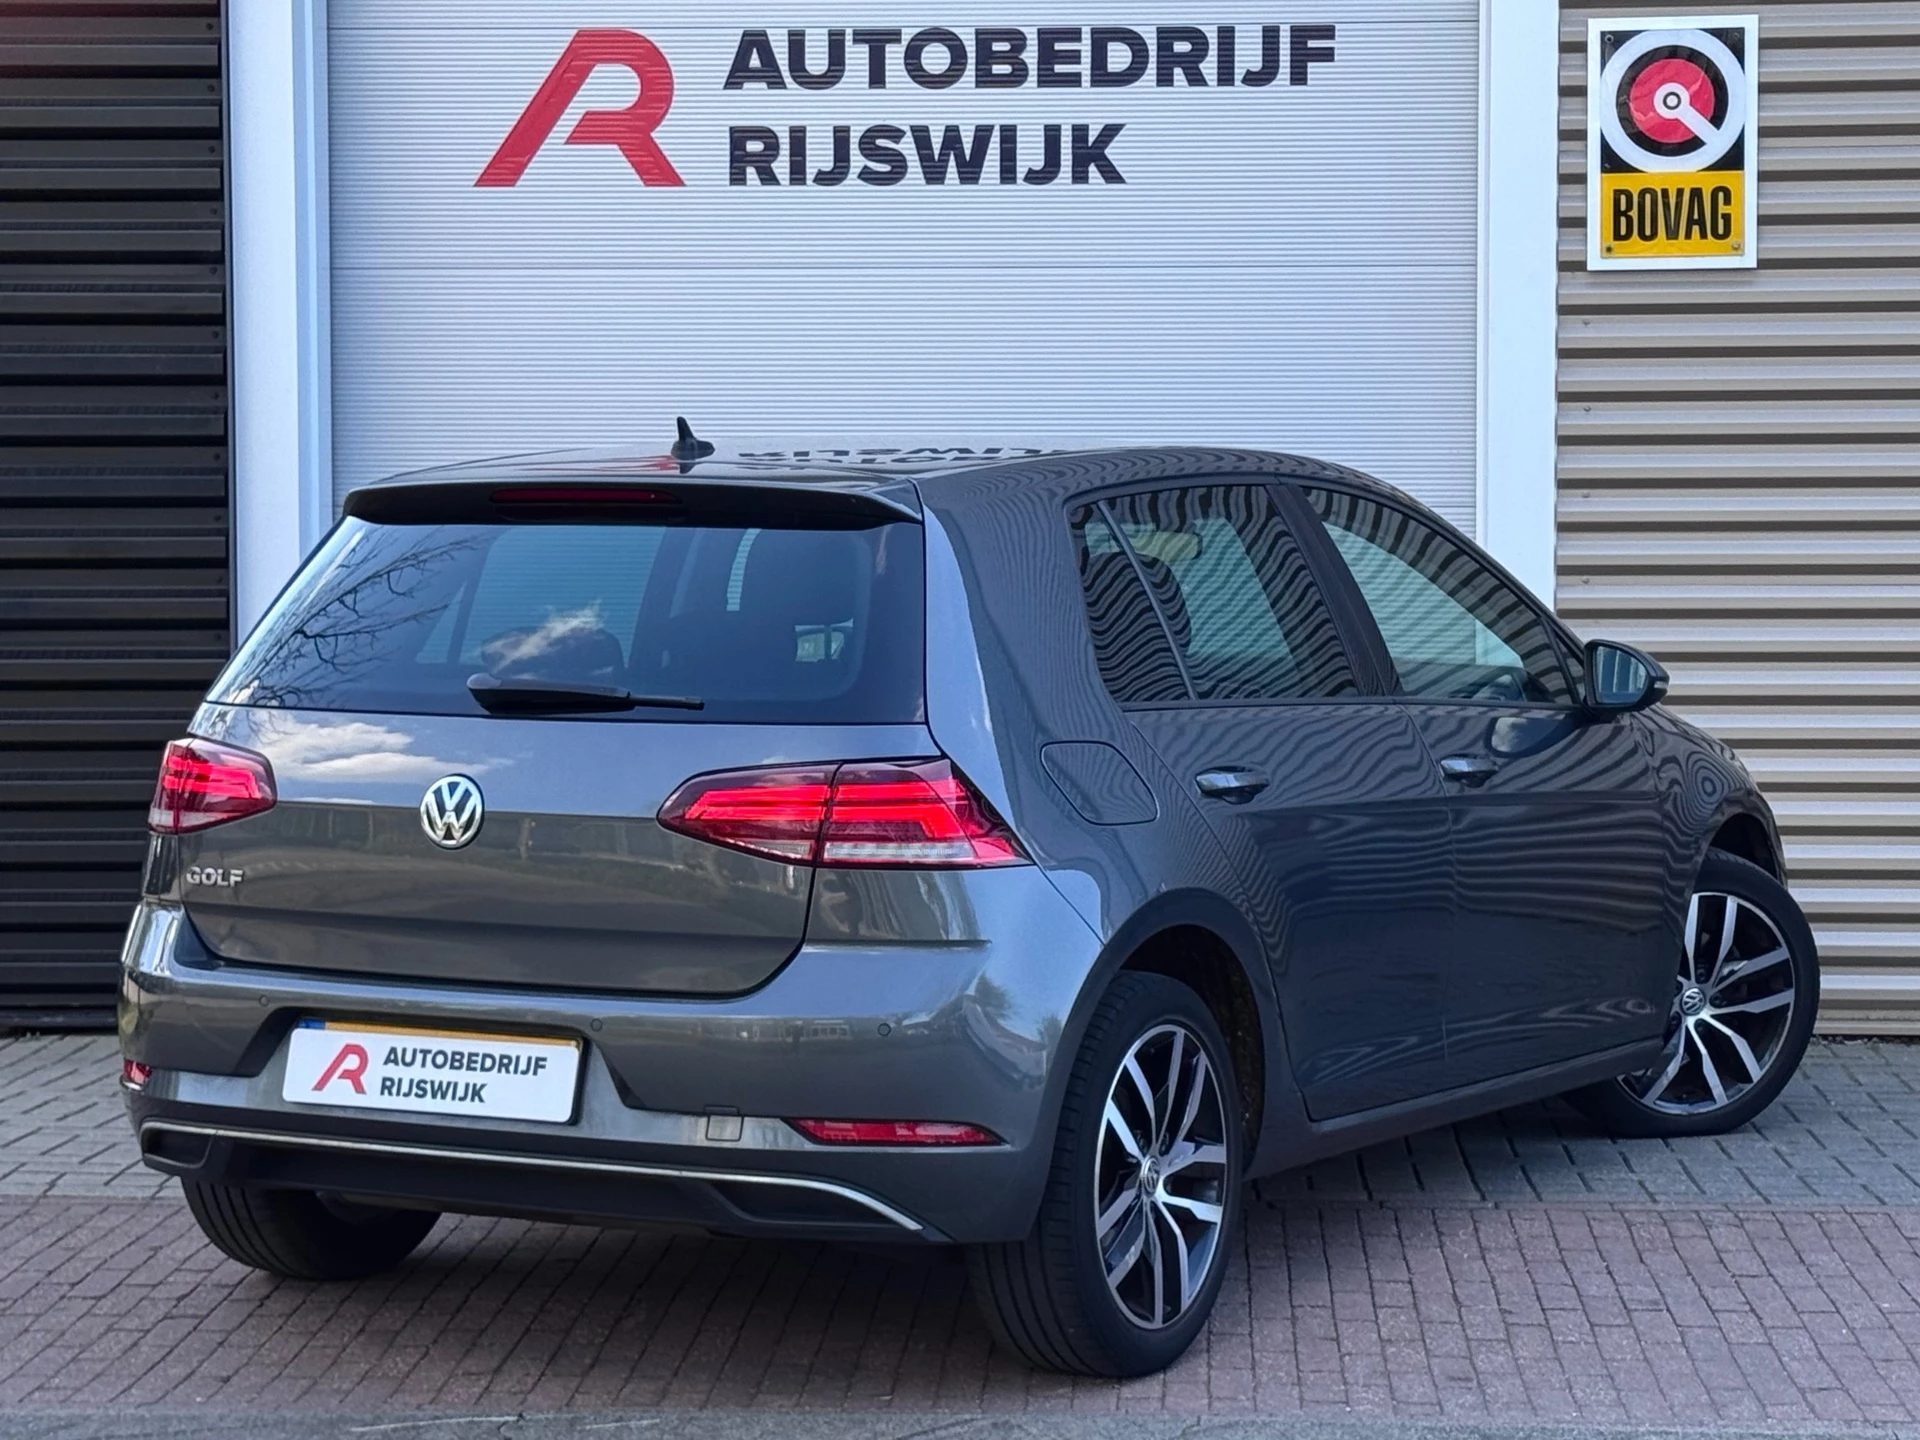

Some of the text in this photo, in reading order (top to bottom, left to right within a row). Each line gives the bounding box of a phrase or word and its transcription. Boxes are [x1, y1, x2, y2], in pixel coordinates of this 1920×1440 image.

[723, 25, 1335, 90] AUTOBEDRIJF
[729, 124, 1127, 187] RIJSWIJK
[1612, 186, 1732, 242] BOVAG
[186, 866, 245, 888] GOLF
[382, 1046, 548, 1077] AUTOBEDRIJF
[379, 1076, 488, 1103] RIJSWIJK
